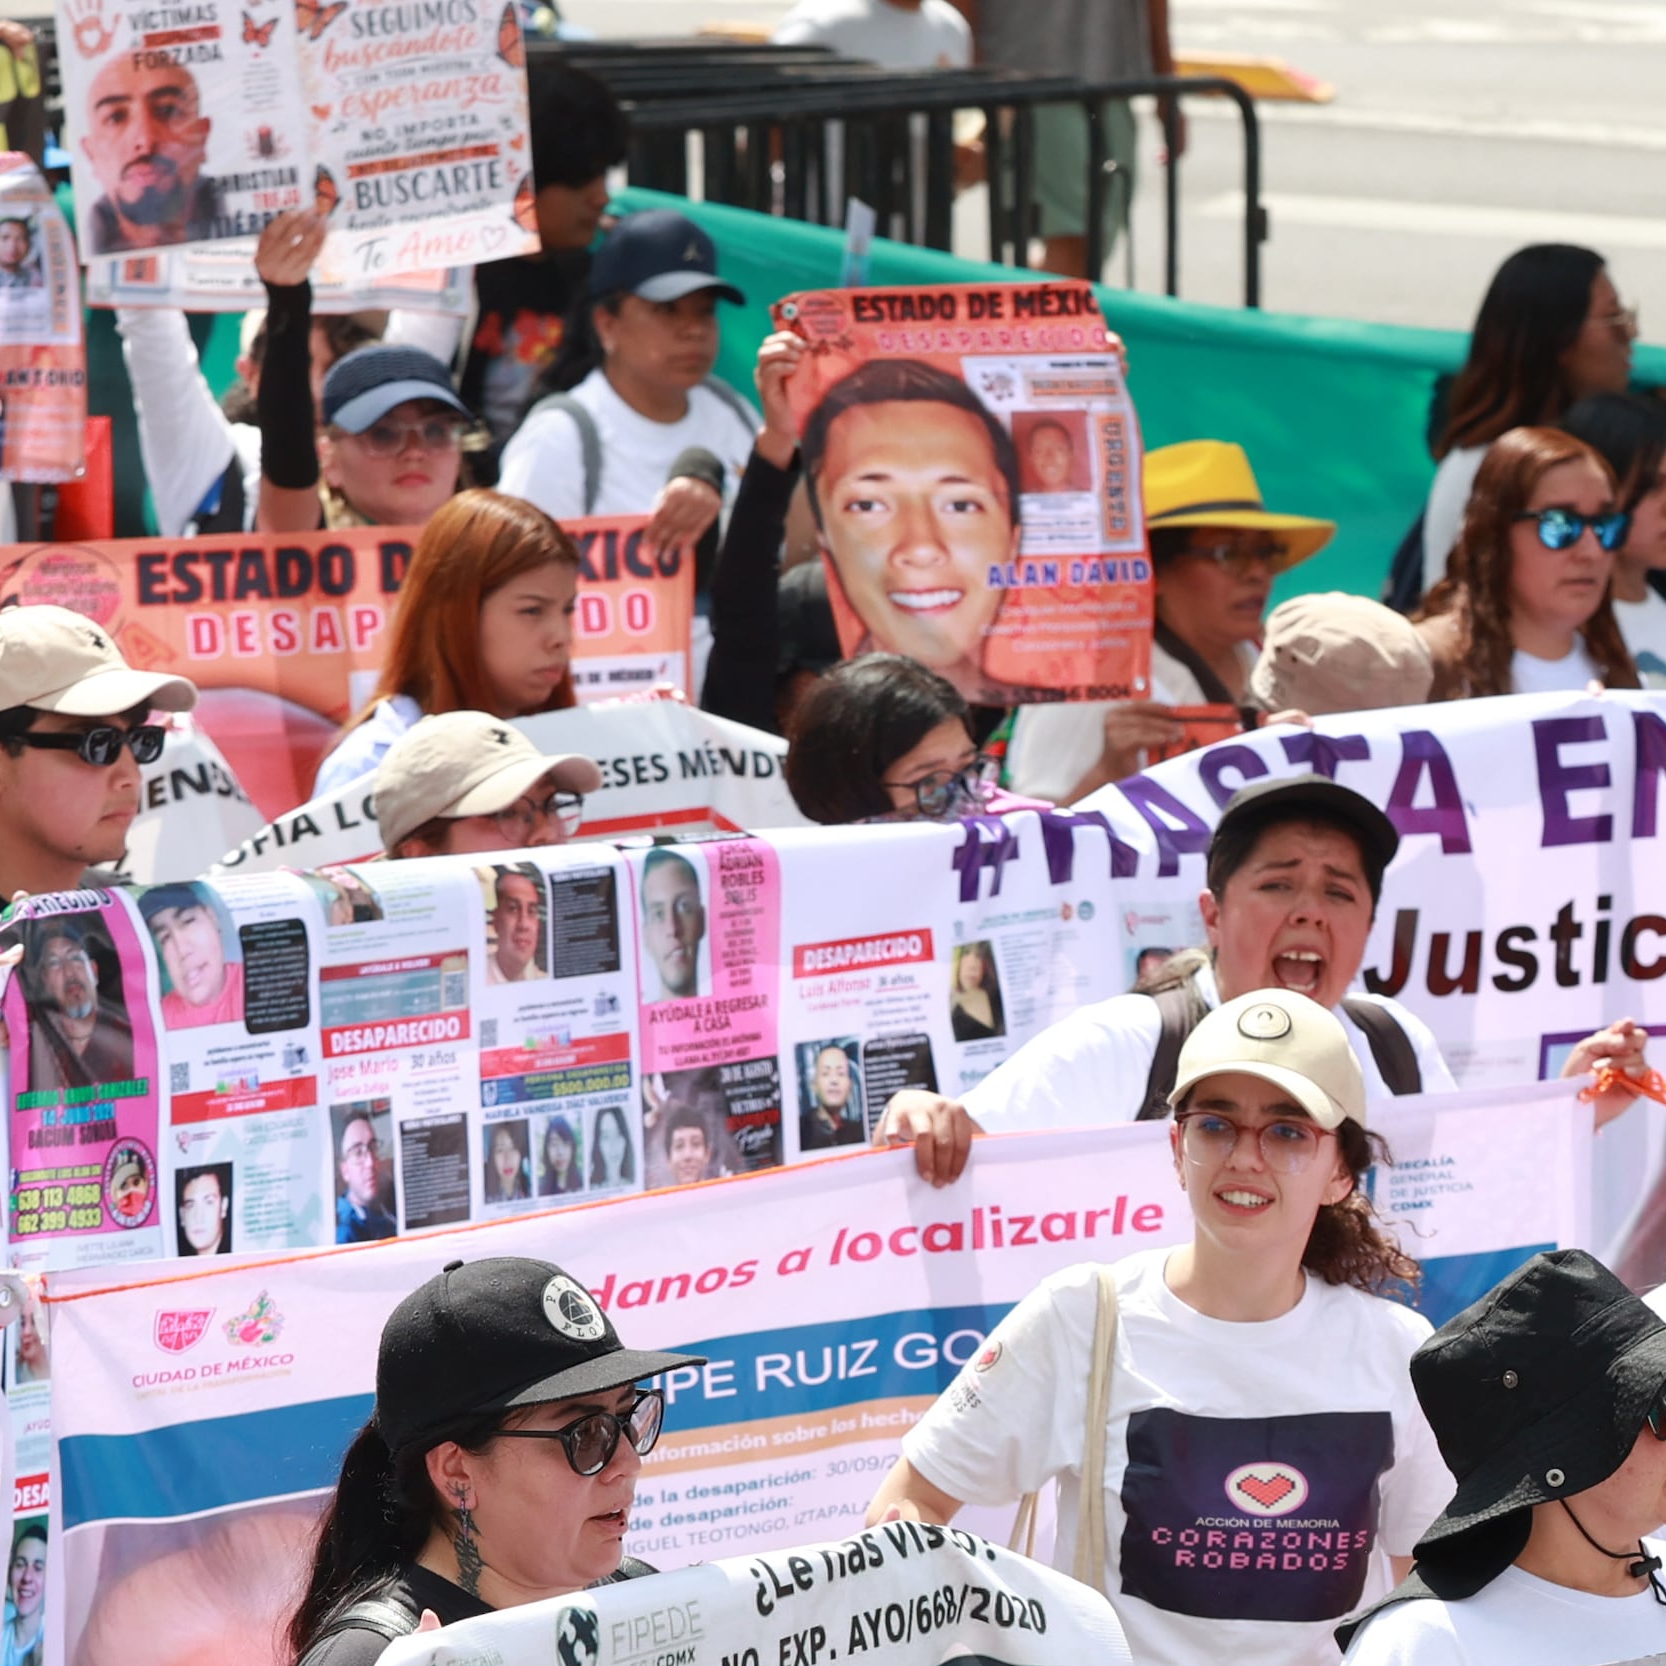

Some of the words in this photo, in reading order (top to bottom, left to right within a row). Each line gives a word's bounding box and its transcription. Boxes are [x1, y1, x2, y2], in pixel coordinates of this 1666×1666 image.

[350, 2, 477, 39] SEGUIMOS
[133, 46, 224, 71] FORZADA
[354, 160, 503, 211] BUSCARTE
[852, 295, 957, 323] ESTADO
[967, 292, 1003, 320] DE
[1013, 284, 1101, 319] MÉXIC
[878, 323, 1110, 352] DESAPARECIDO
[136, 543, 357, 606] ESTADO
[987, 562, 1059, 587] ALAN
[1070, 559, 1151, 584] DAVID
[802, 934, 923, 971] DESAPARECIDO
[330, 1015, 461, 1054] DESAPARECIDO
[776, 1245, 814, 1277] a
[828, 1194, 1166, 1267] localizarle
[132, 1367, 197, 1388] CIUDAD
[200, 1362, 223, 1377] DE
[226, 1352, 295, 1373] MÉXICO
[755, 1337, 880, 1392] RUIZ
[1150, 1525, 1369, 1550] CORAZONES
[1194, 1514, 1249, 1529] ACCIÓN
[1252, 1516, 1272, 1529] DE
[1275, 1516, 1341, 1530] MEMORIA
[1174, 1548, 1351, 1572] ROBADOS
[846, 1584, 1049, 1658] AYO/668/2020
